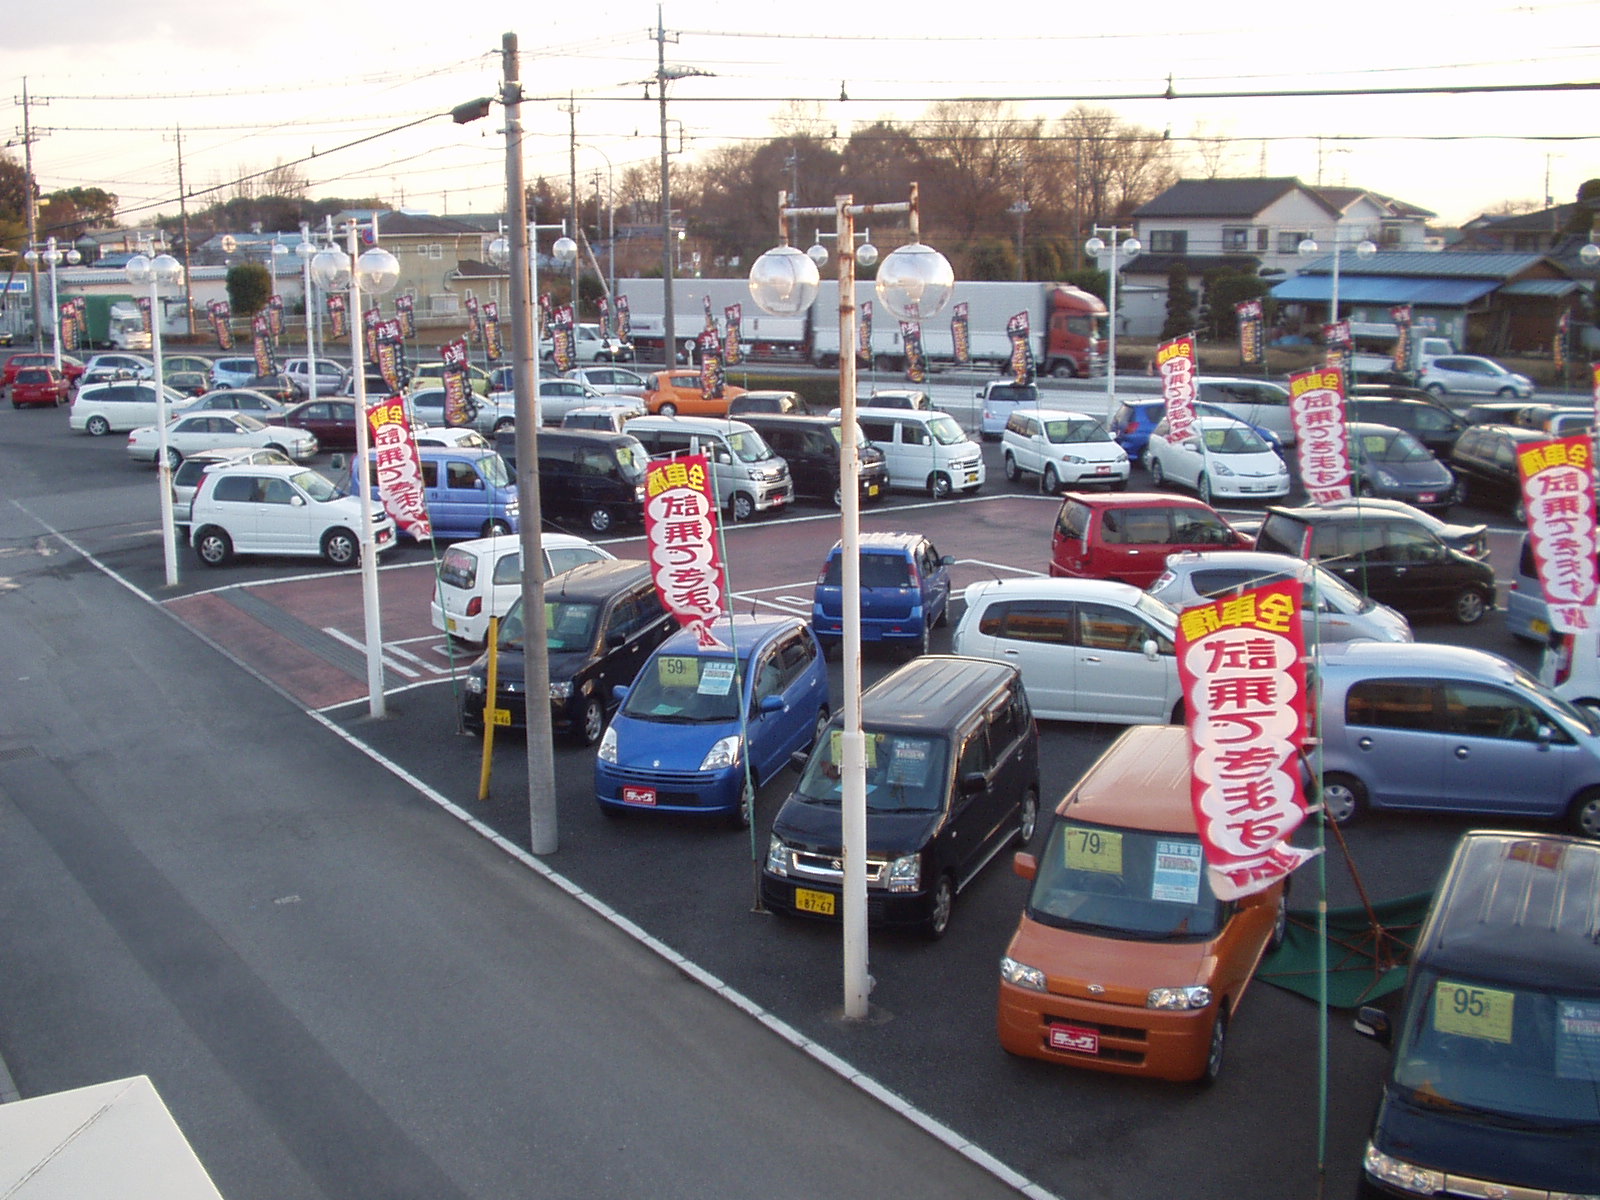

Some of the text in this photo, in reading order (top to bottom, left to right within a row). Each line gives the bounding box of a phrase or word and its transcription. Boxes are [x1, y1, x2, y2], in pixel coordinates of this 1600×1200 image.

[667, 658, 683, 674] 59
[1078, 831, 1101, 854] 79
[1453, 988, 1485, 1016] 95
